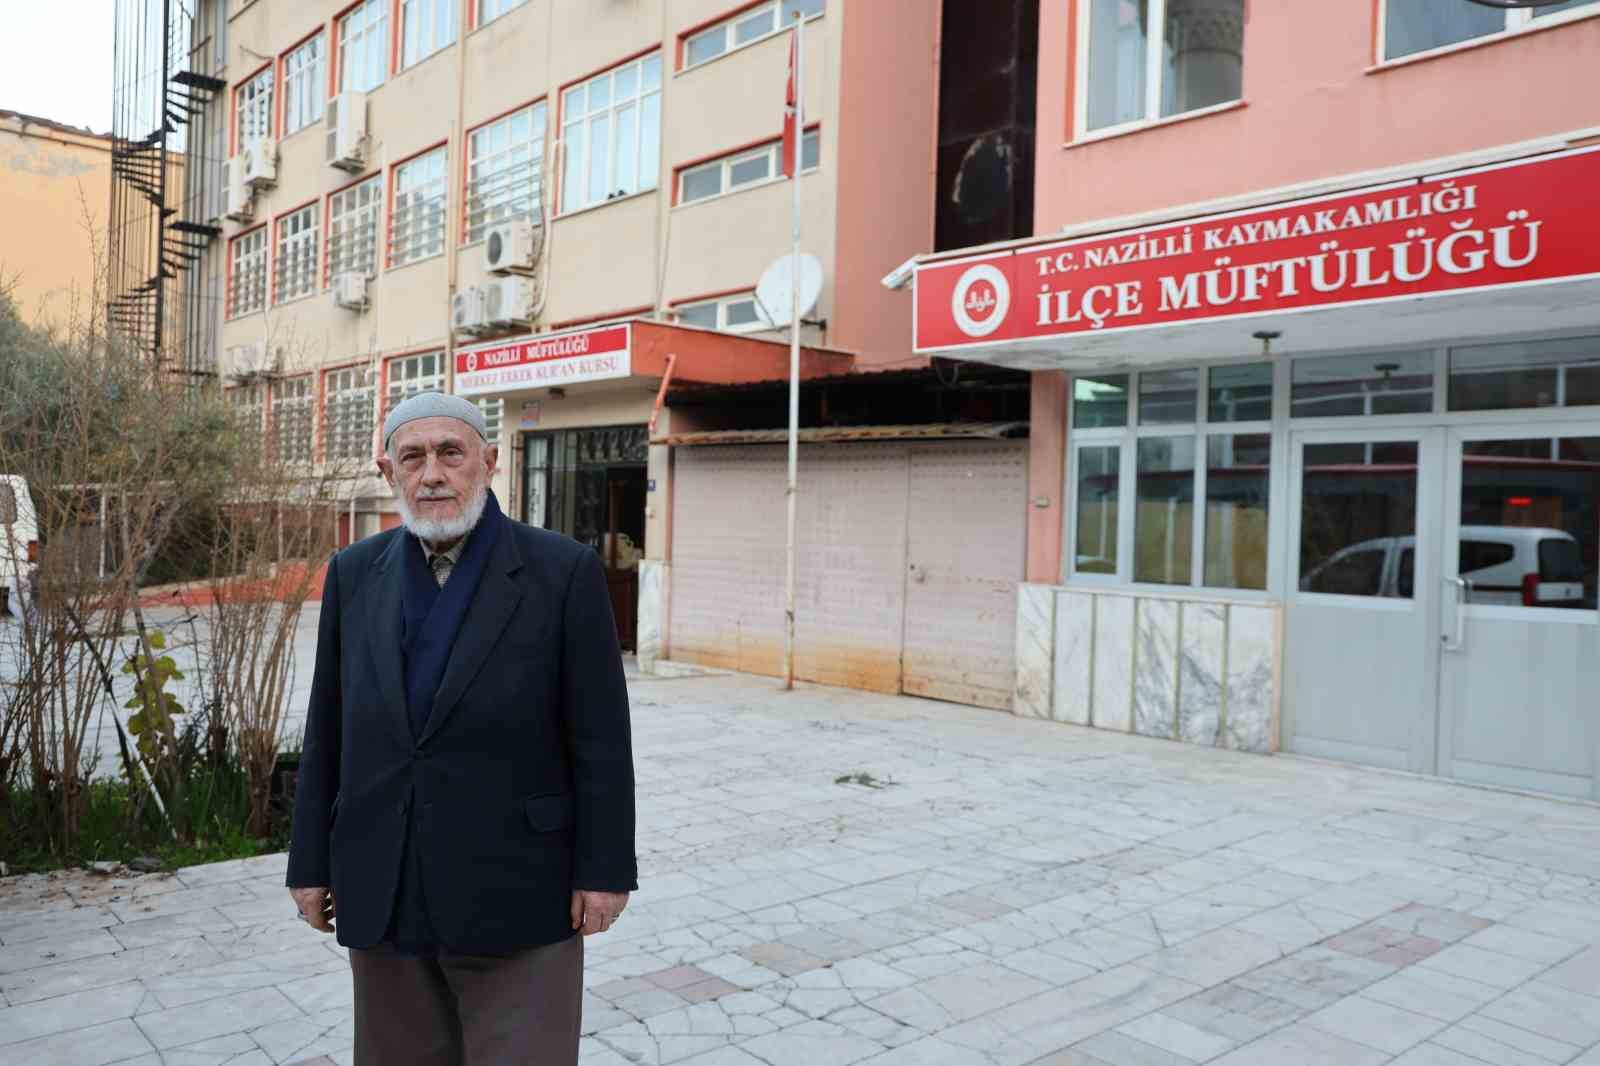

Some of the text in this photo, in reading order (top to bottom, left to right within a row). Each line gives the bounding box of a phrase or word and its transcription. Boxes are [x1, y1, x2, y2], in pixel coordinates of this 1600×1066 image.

[1036, 182, 1478, 276] T.C. NAZİLLİ KAYMAKAMLIĞI
[1036, 209, 1543, 329] İLÇE MÜFTÜLÜĞÜ
